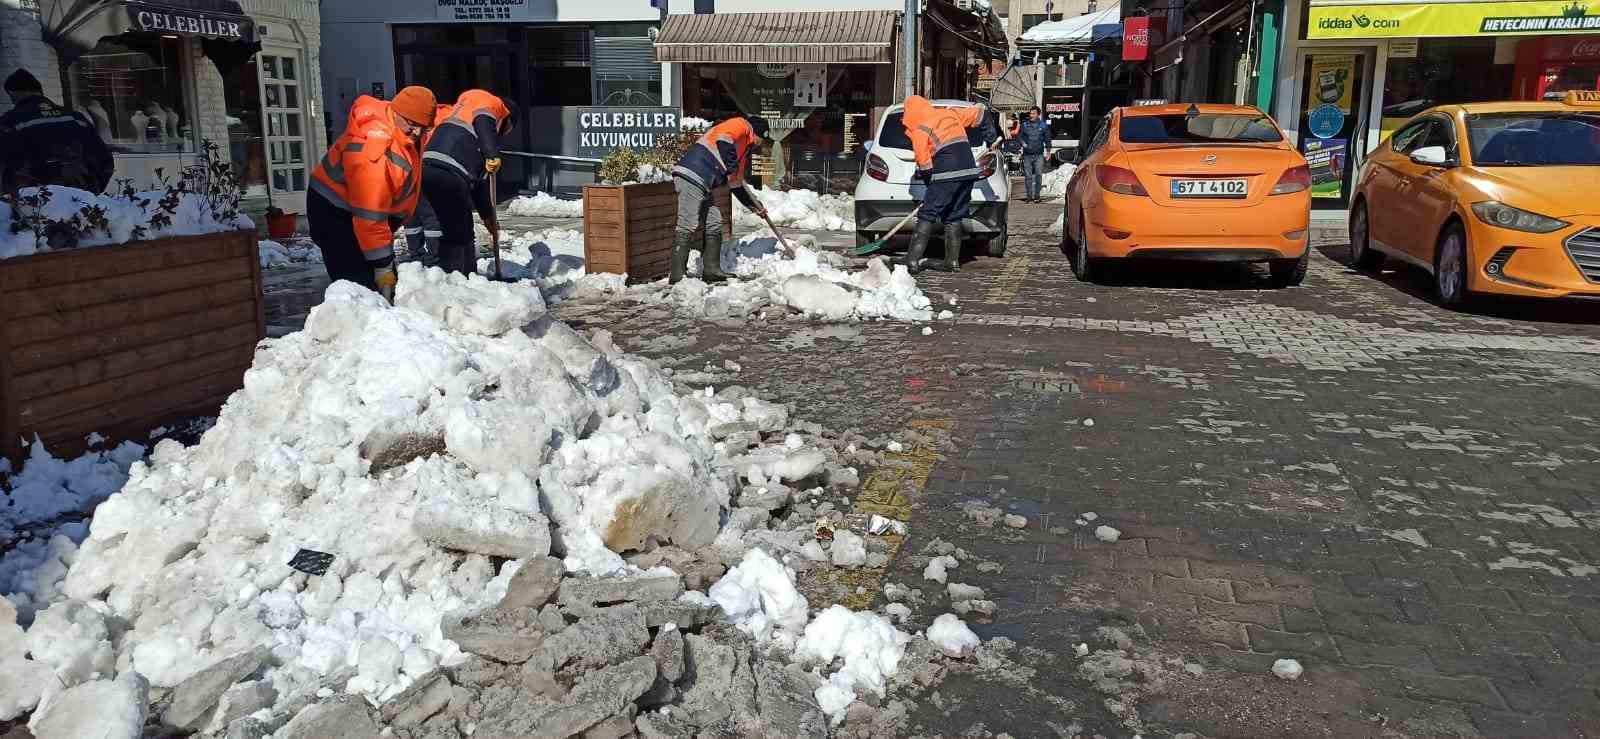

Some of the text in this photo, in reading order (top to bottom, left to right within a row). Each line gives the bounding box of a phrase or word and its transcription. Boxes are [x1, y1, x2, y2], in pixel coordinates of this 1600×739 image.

[138, 11, 241, 37] ÇELEBİLER
[1318, 17, 1400, 29] iddaa com
[1484, 18, 1547, 31] HEYECANIN
[1547, 17, 1584, 29] KRALI
[580, 112, 676, 129] ÇELEBİLER
[1178, 181, 1245, 193] 67 T 4102
